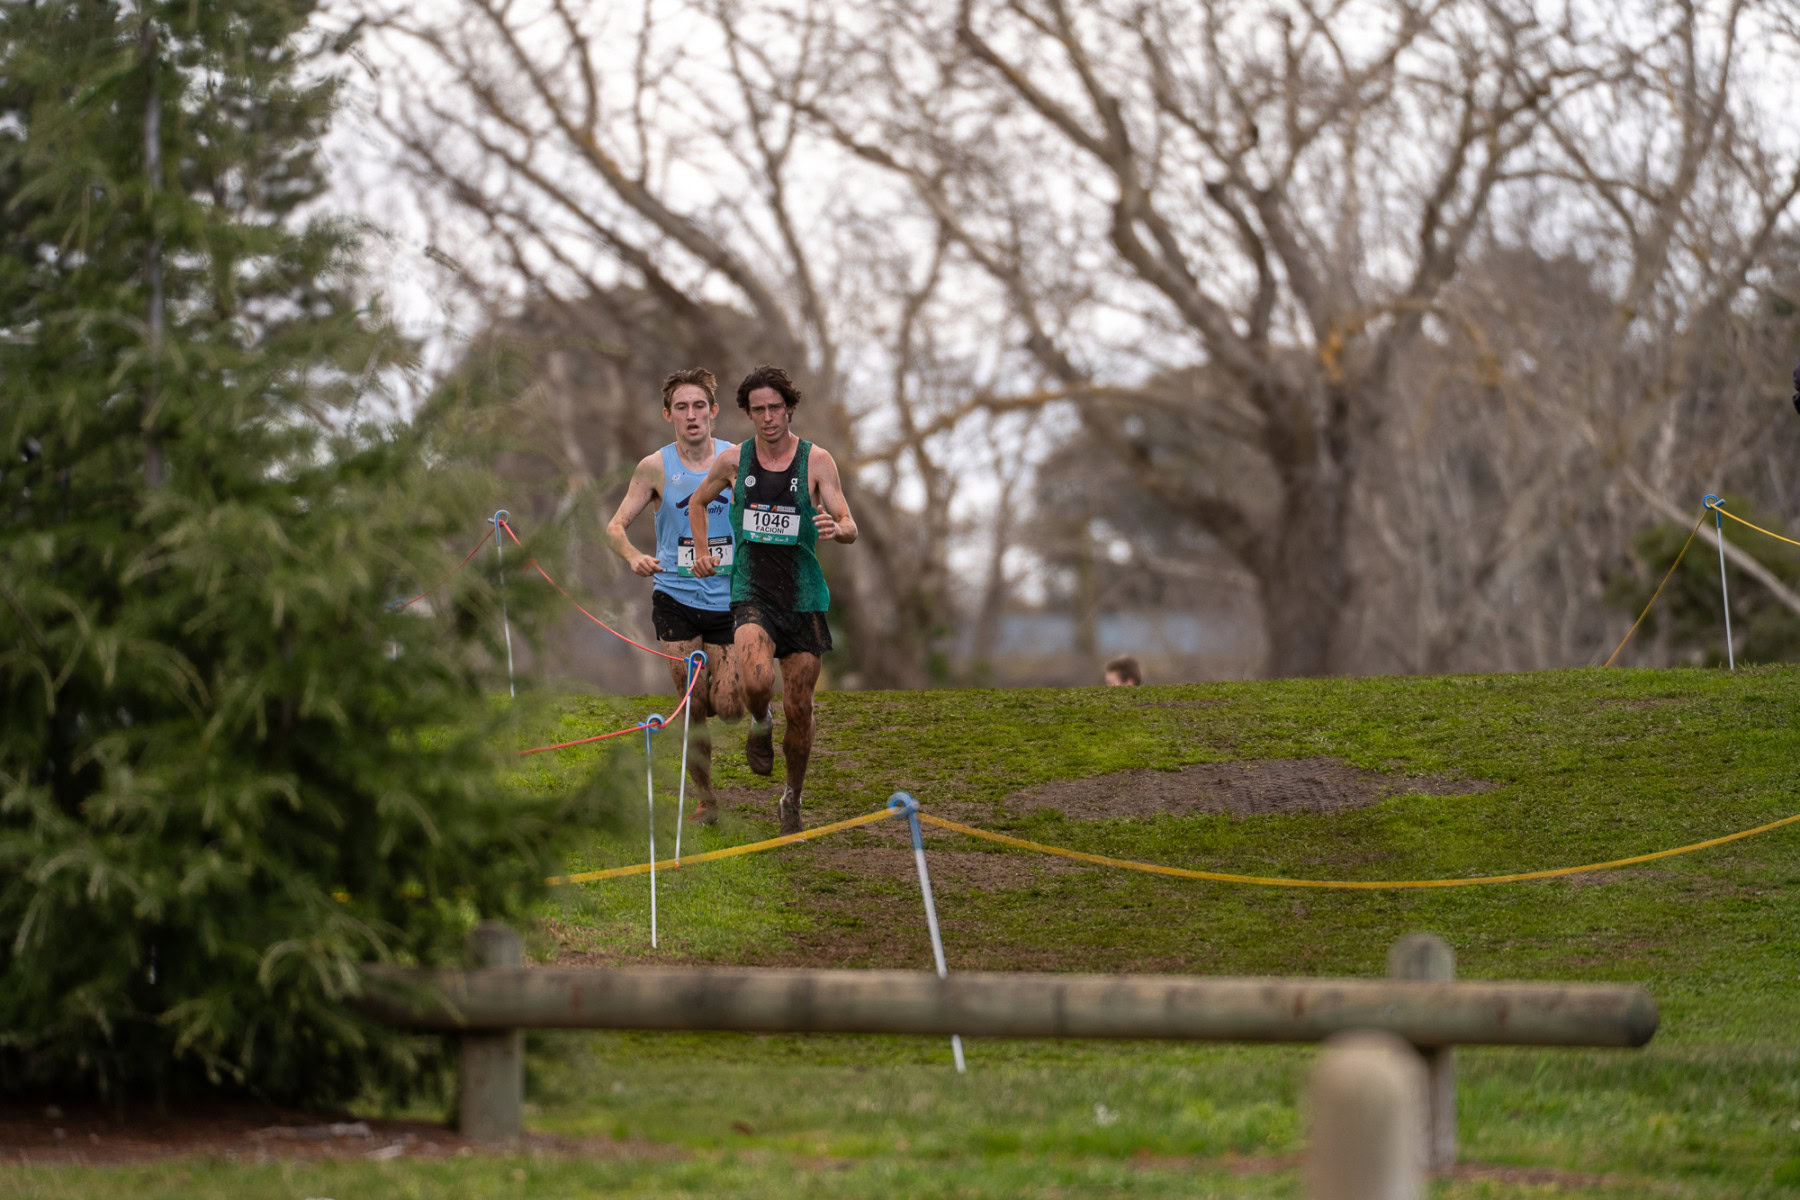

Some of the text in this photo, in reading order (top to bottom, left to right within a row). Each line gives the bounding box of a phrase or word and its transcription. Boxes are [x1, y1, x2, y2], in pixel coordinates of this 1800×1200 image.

[753, 512, 790, 529] 1046
[756, 526, 784, 534] FACIONI
[688, 547, 723, 561] 113
